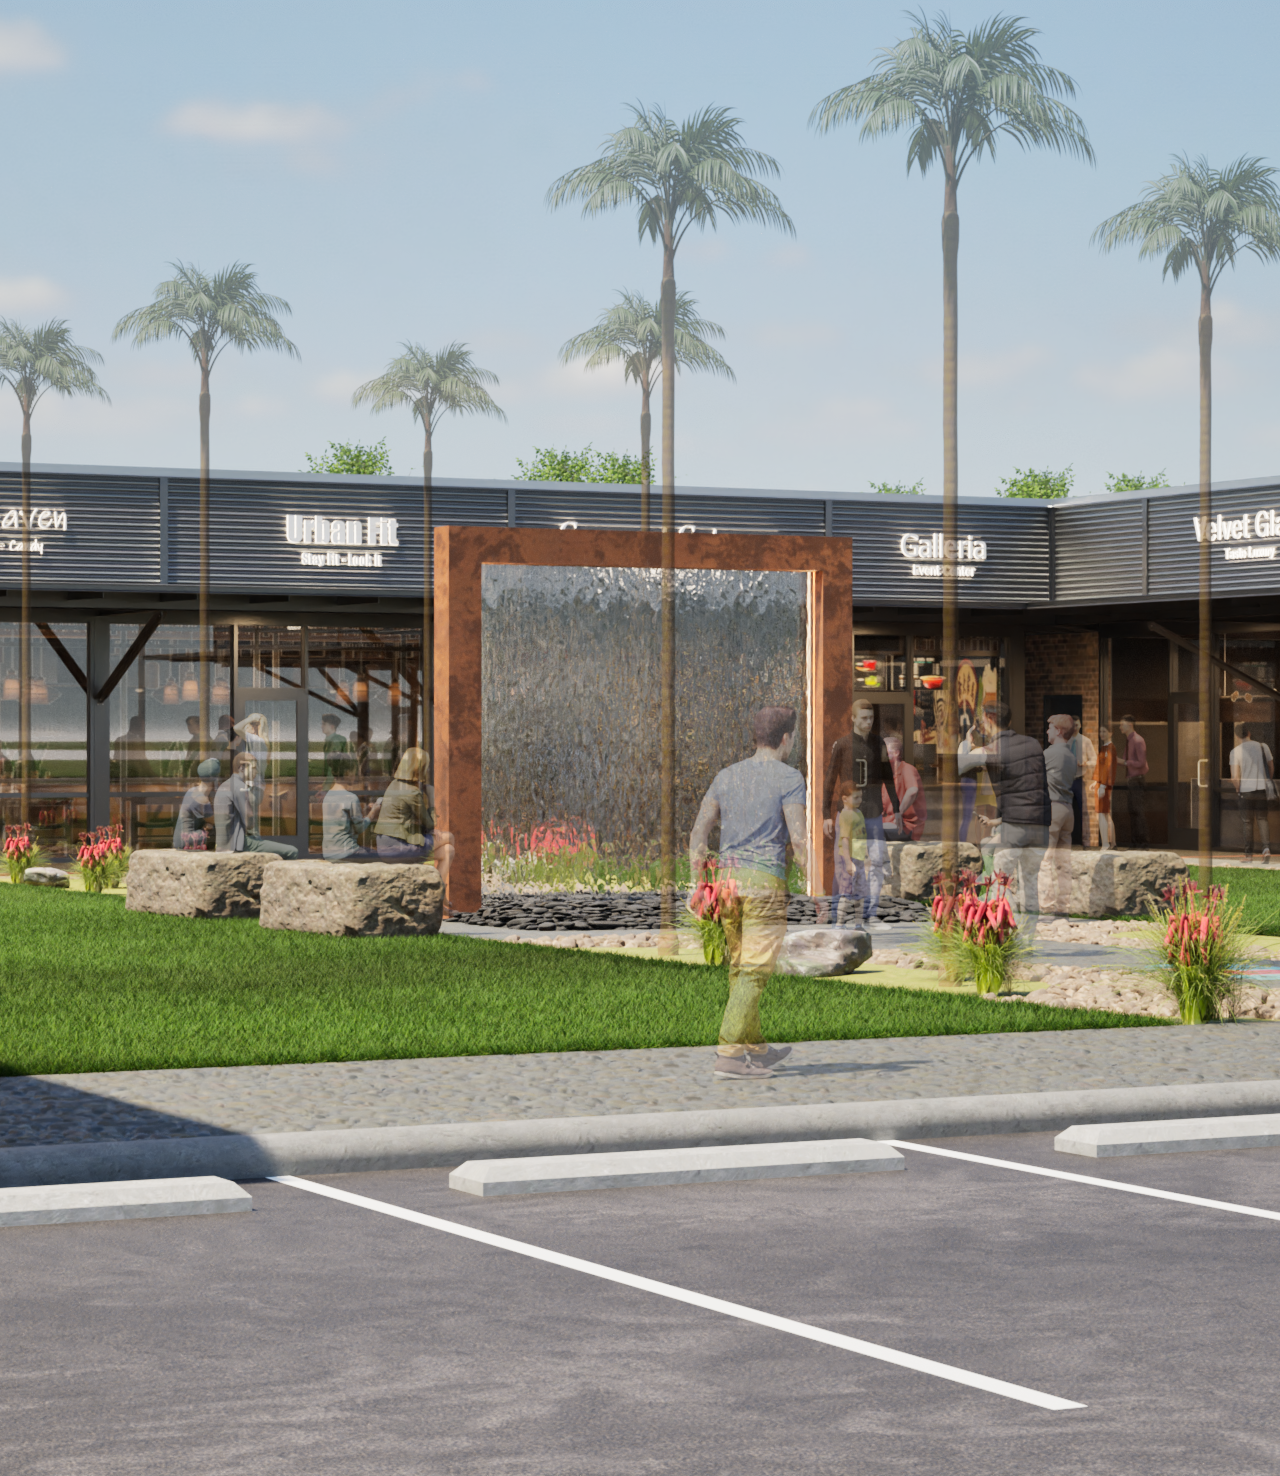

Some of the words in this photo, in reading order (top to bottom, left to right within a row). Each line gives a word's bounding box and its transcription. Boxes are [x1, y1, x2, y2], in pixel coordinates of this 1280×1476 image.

[286, 514, 363, 545] Urban
[367, 516, 399, 546] Fit
[1192, 513, 1251, 542] Velvet
[301, 551, 326, 567] Stay
[900, 532, 987, 559] Galleria
[911, 563, 942, 577] Event
